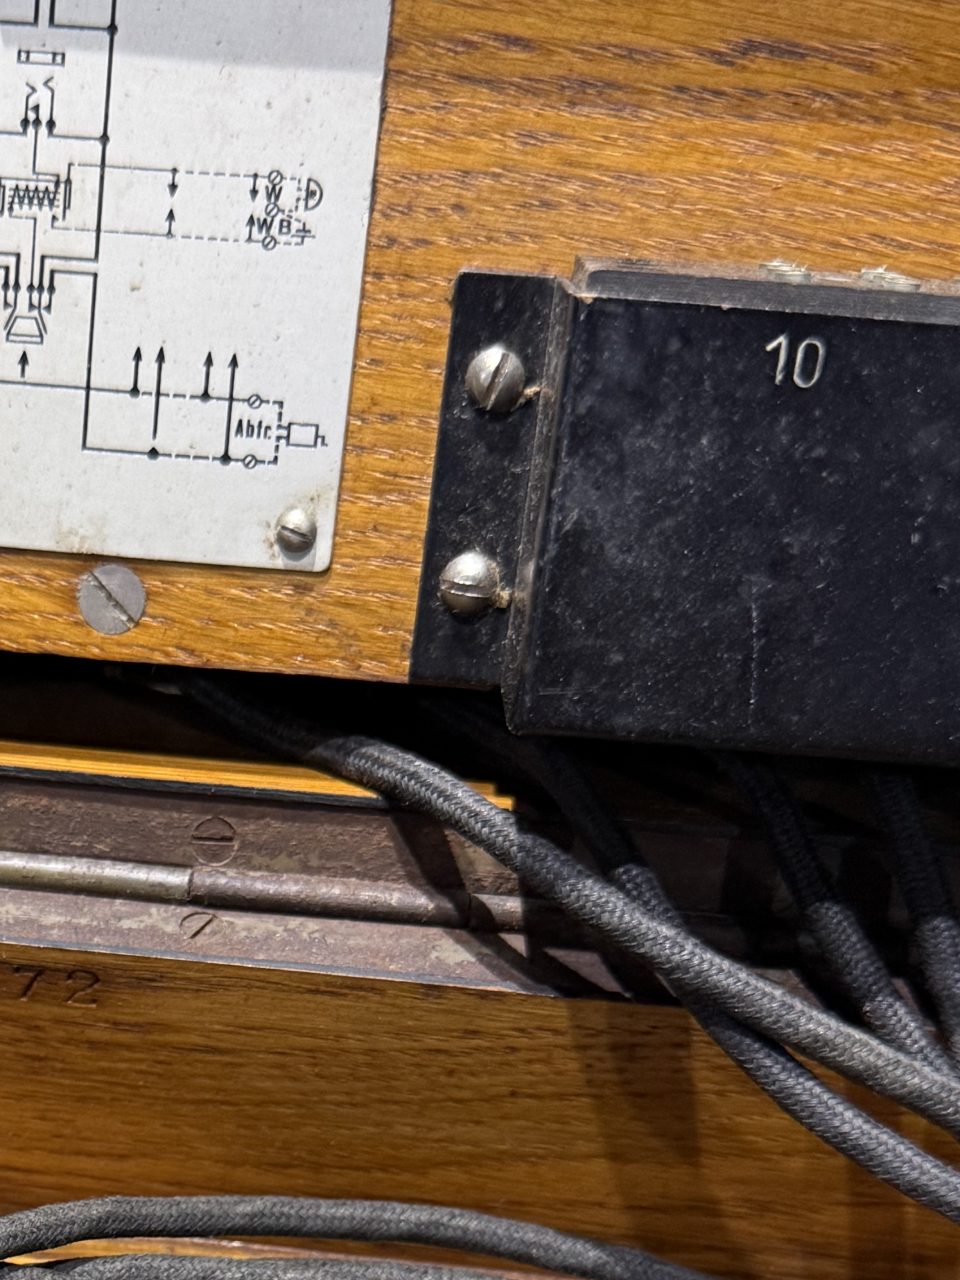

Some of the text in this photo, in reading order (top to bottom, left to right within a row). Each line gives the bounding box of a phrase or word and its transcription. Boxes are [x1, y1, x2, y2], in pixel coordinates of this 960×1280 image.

[265, 185, 283, 202] W
[765, 332, 828, 389] 10
[234, 419, 272, 440] Abfr.
